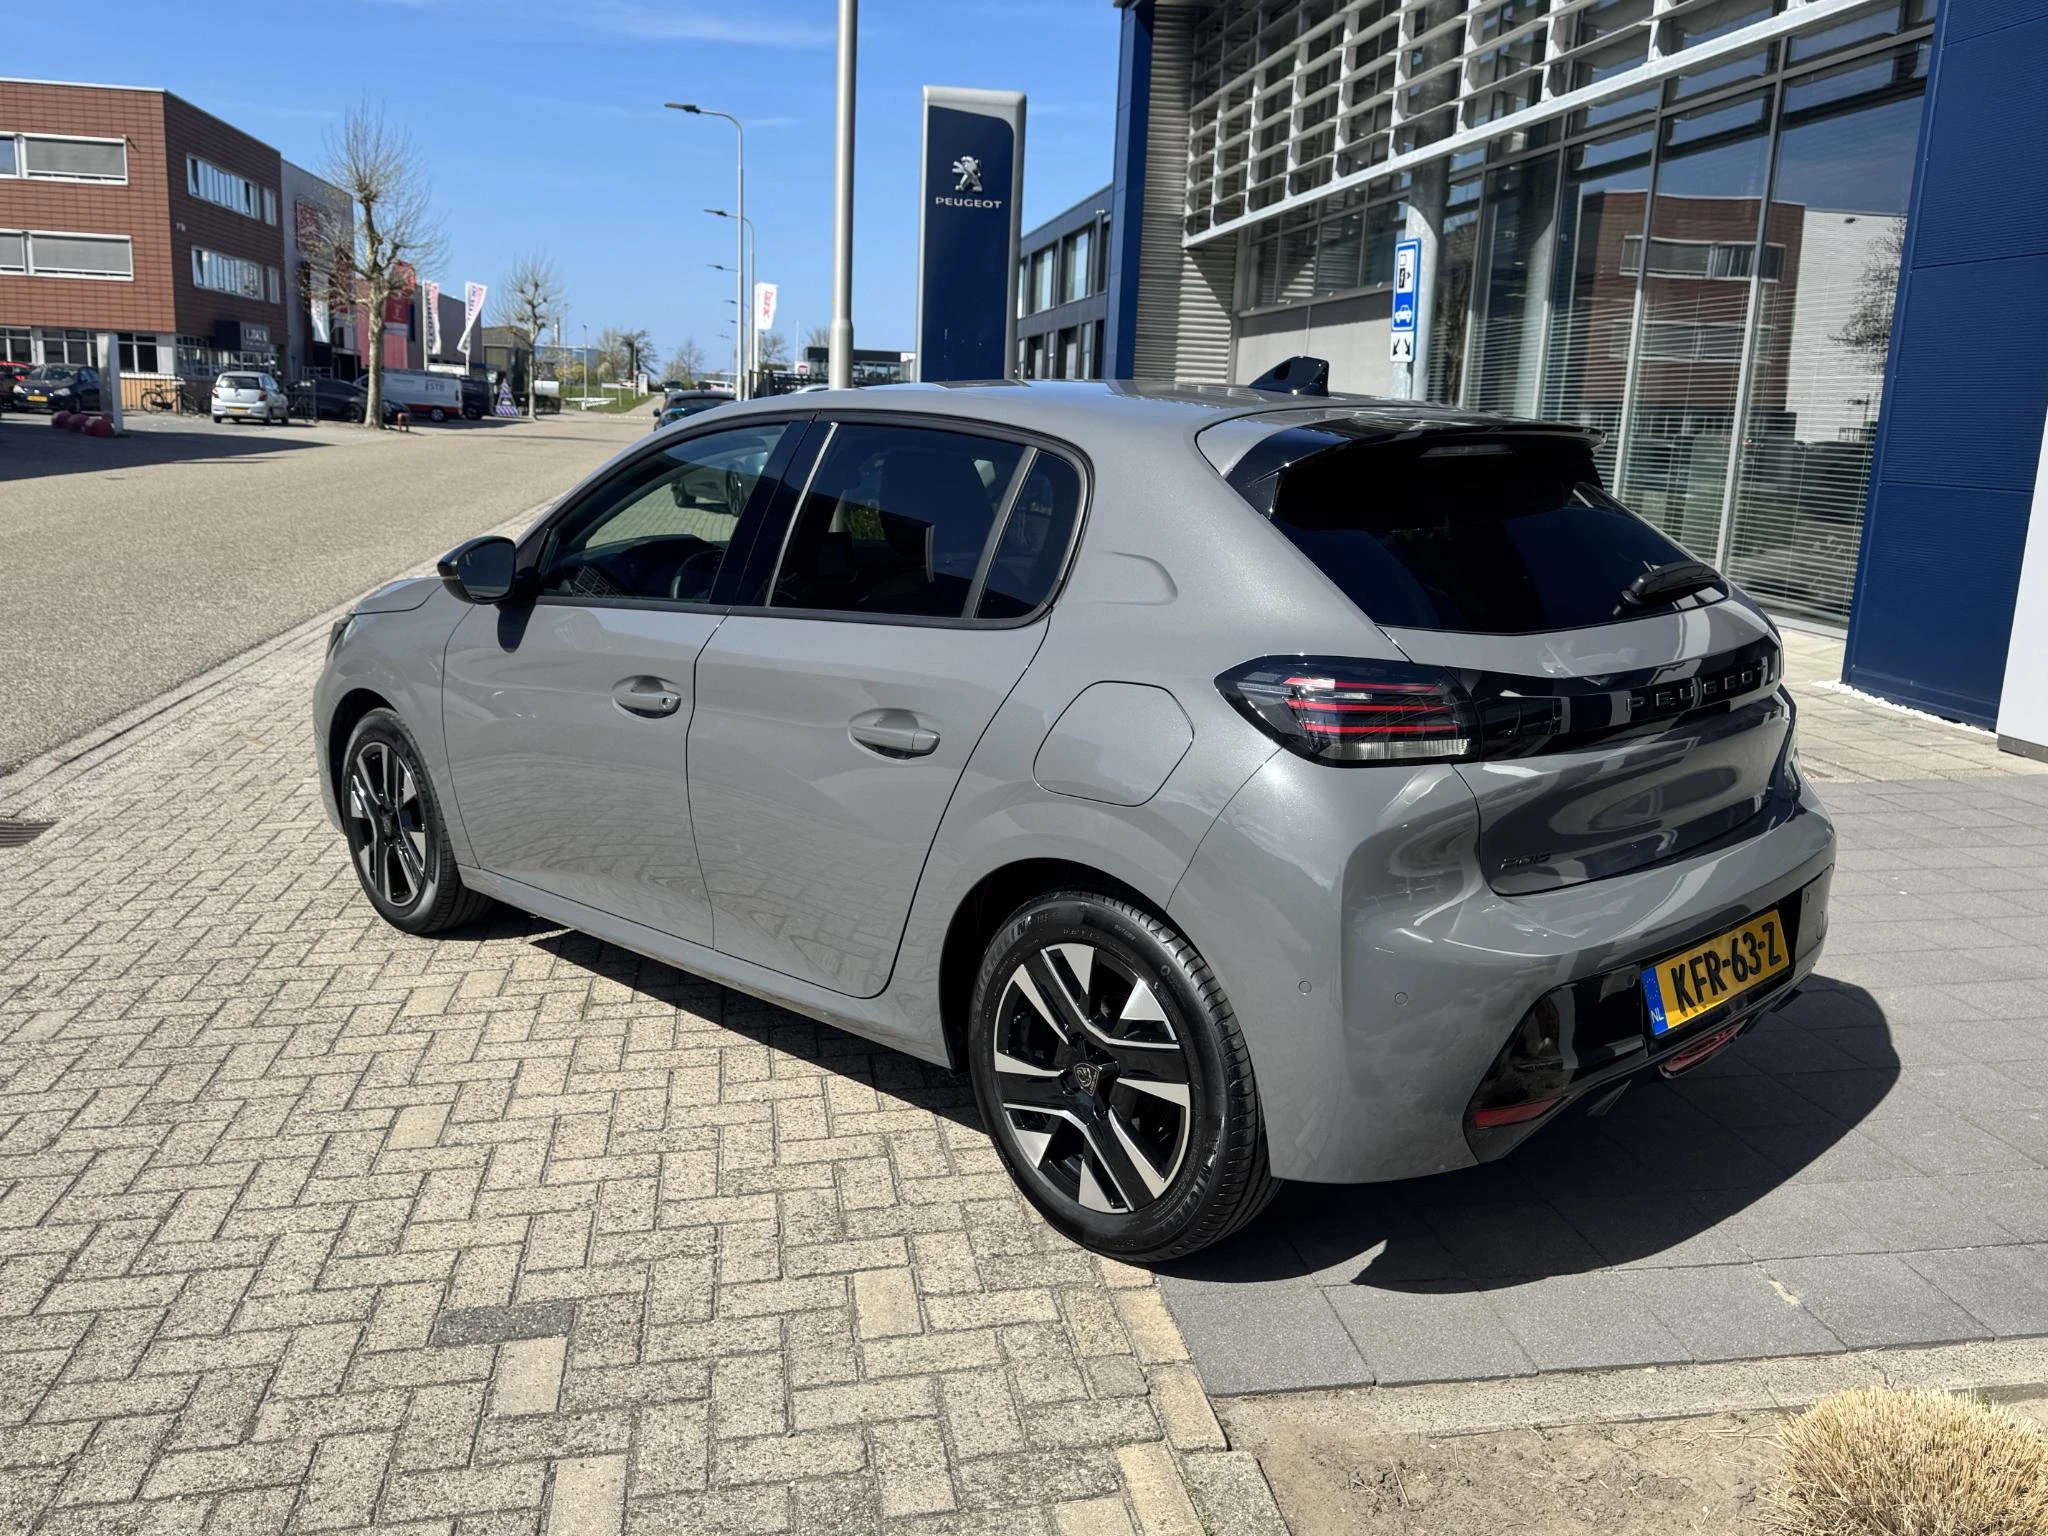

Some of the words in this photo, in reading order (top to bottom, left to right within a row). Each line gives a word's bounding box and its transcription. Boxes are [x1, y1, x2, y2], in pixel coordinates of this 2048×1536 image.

[935, 196, 1002, 209] PEUGEOT
[1625, 656, 1768, 712] PEUGEOT
[1670, 921, 1782, 1015] KFR-63-Z
[1651, 1007, 1664, 1023] NL
